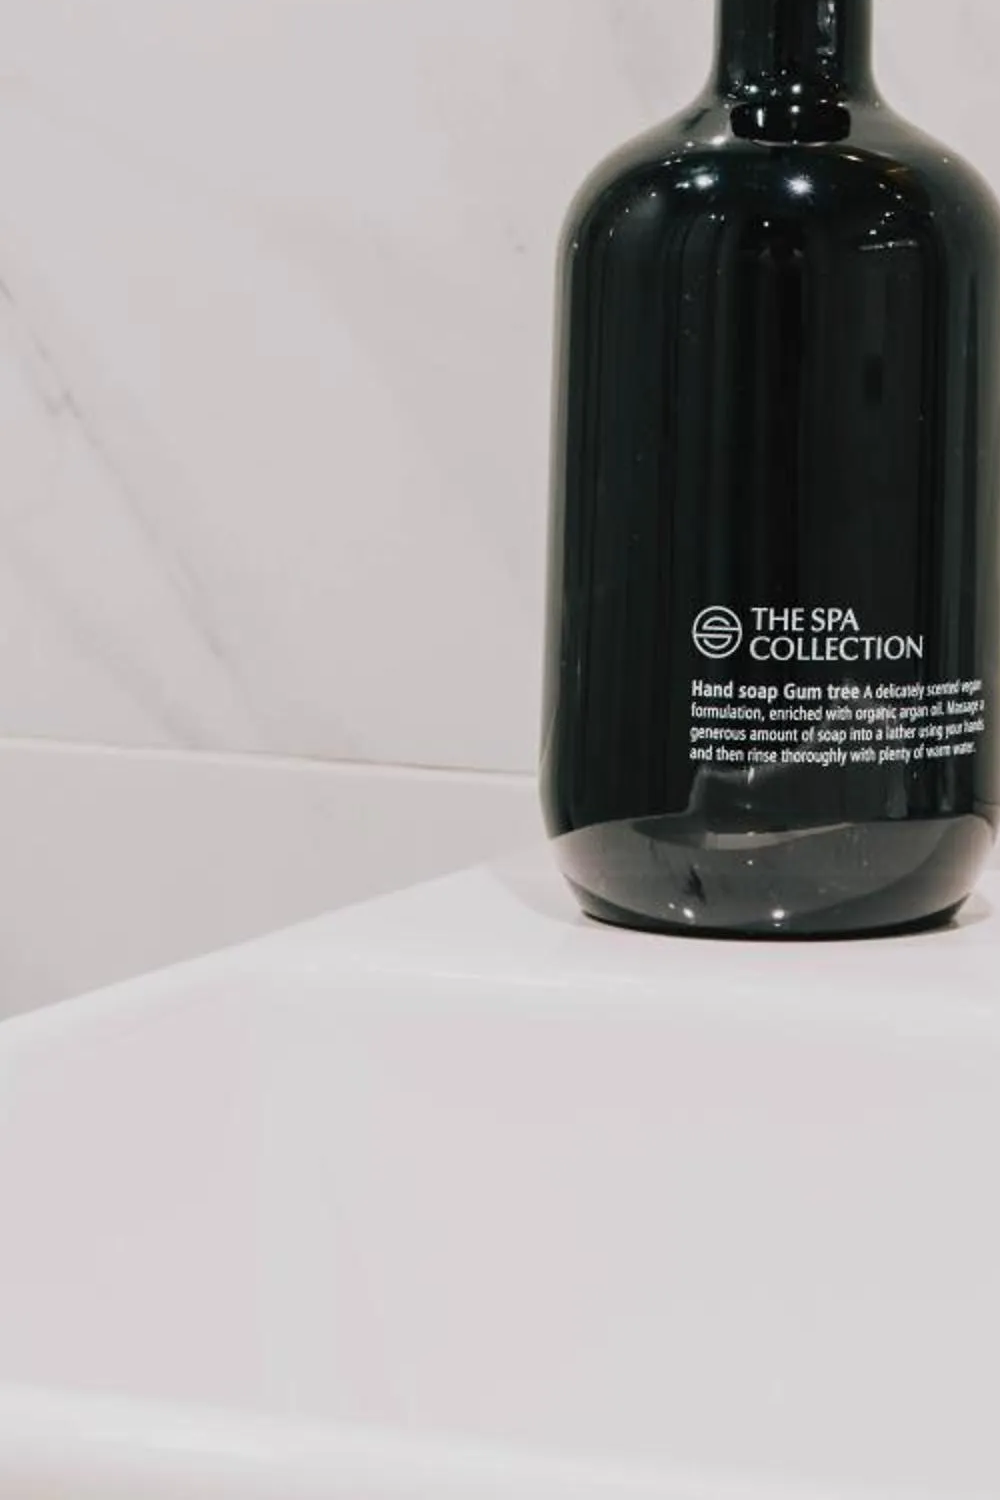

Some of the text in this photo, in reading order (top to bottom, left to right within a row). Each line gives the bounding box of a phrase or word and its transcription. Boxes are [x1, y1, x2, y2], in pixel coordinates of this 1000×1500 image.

[752, 607, 860, 632] THE SPA
[750, 636, 924, 661] COLLECTION
[691, 680, 734, 699] Hand
[739, 685, 778, 703] soap
[783, 683, 822, 700] Gum
[827, 684, 860, 700] tree
[863, 685, 873, 699] A
[875, 682, 924, 700] delicately
[926, 679, 960, 697] scented
[691, 702, 765, 722] formulation,
[769, 705, 823, 721] enriched
[826, 705, 853, 720] with
[855, 704, 897, 724] organic
[899, 705, 929, 722] argan
[930, 701, 944, 716] oil.
[946, 699, 978, 715] Massage
[690, 727, 747, 742] generous
[749, 727, 799, 741] amount
[801, 726, 815, 741] of
[817, 727, 847, 745] soap
[849, 727, 873, 741] into
[875, 728, 883, 740] a
[885, 724, 916, 740] lather
[917, 723, 944, 740] using
[945, 722, 962, 739] your
[689, 744, 713, 760] and
[715, 745, 744, 761] then
[747, 747, 777, 761] rinse
[780, 747, 847, 767] thoroughly
[849, 746, 877, 762] with
[878, 745, 911, 765] plenty
[913, 742, 925, 760] of
[925, 744, 951, 759] warm
